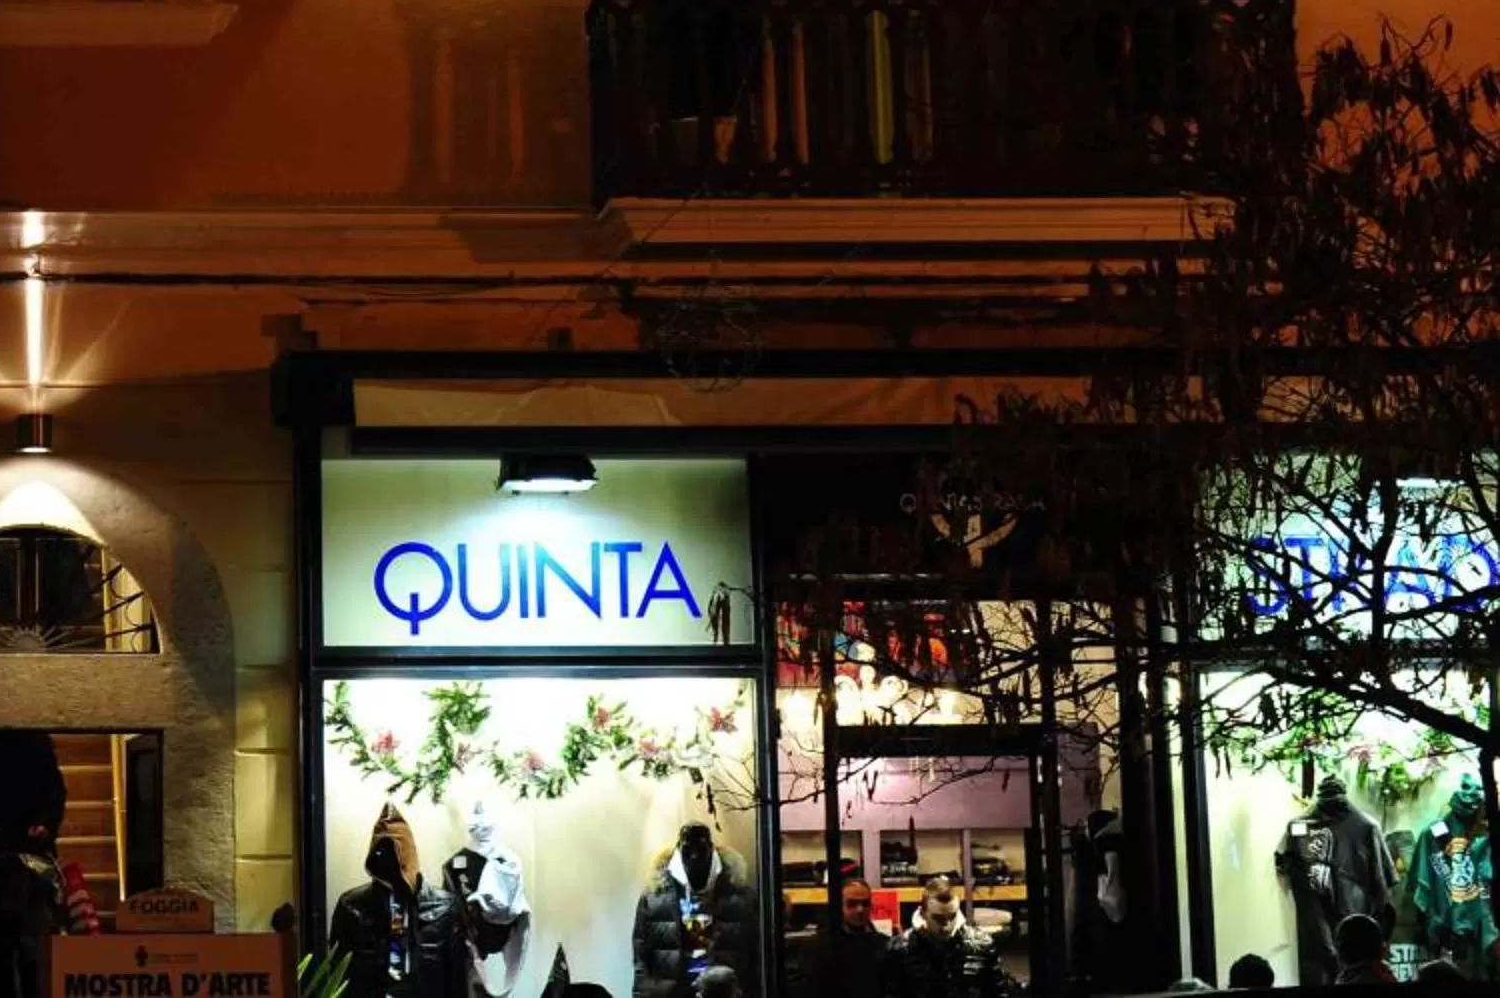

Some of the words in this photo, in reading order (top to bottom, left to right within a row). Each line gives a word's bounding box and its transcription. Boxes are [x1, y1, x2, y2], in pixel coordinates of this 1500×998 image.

[374, 541, 702, 635] QUINTA
[129, 900, 198, 914] FOGGIA
[65, 973, 171, 997] MOSTRA
[181, 972, 271, 996] D'ARTE
